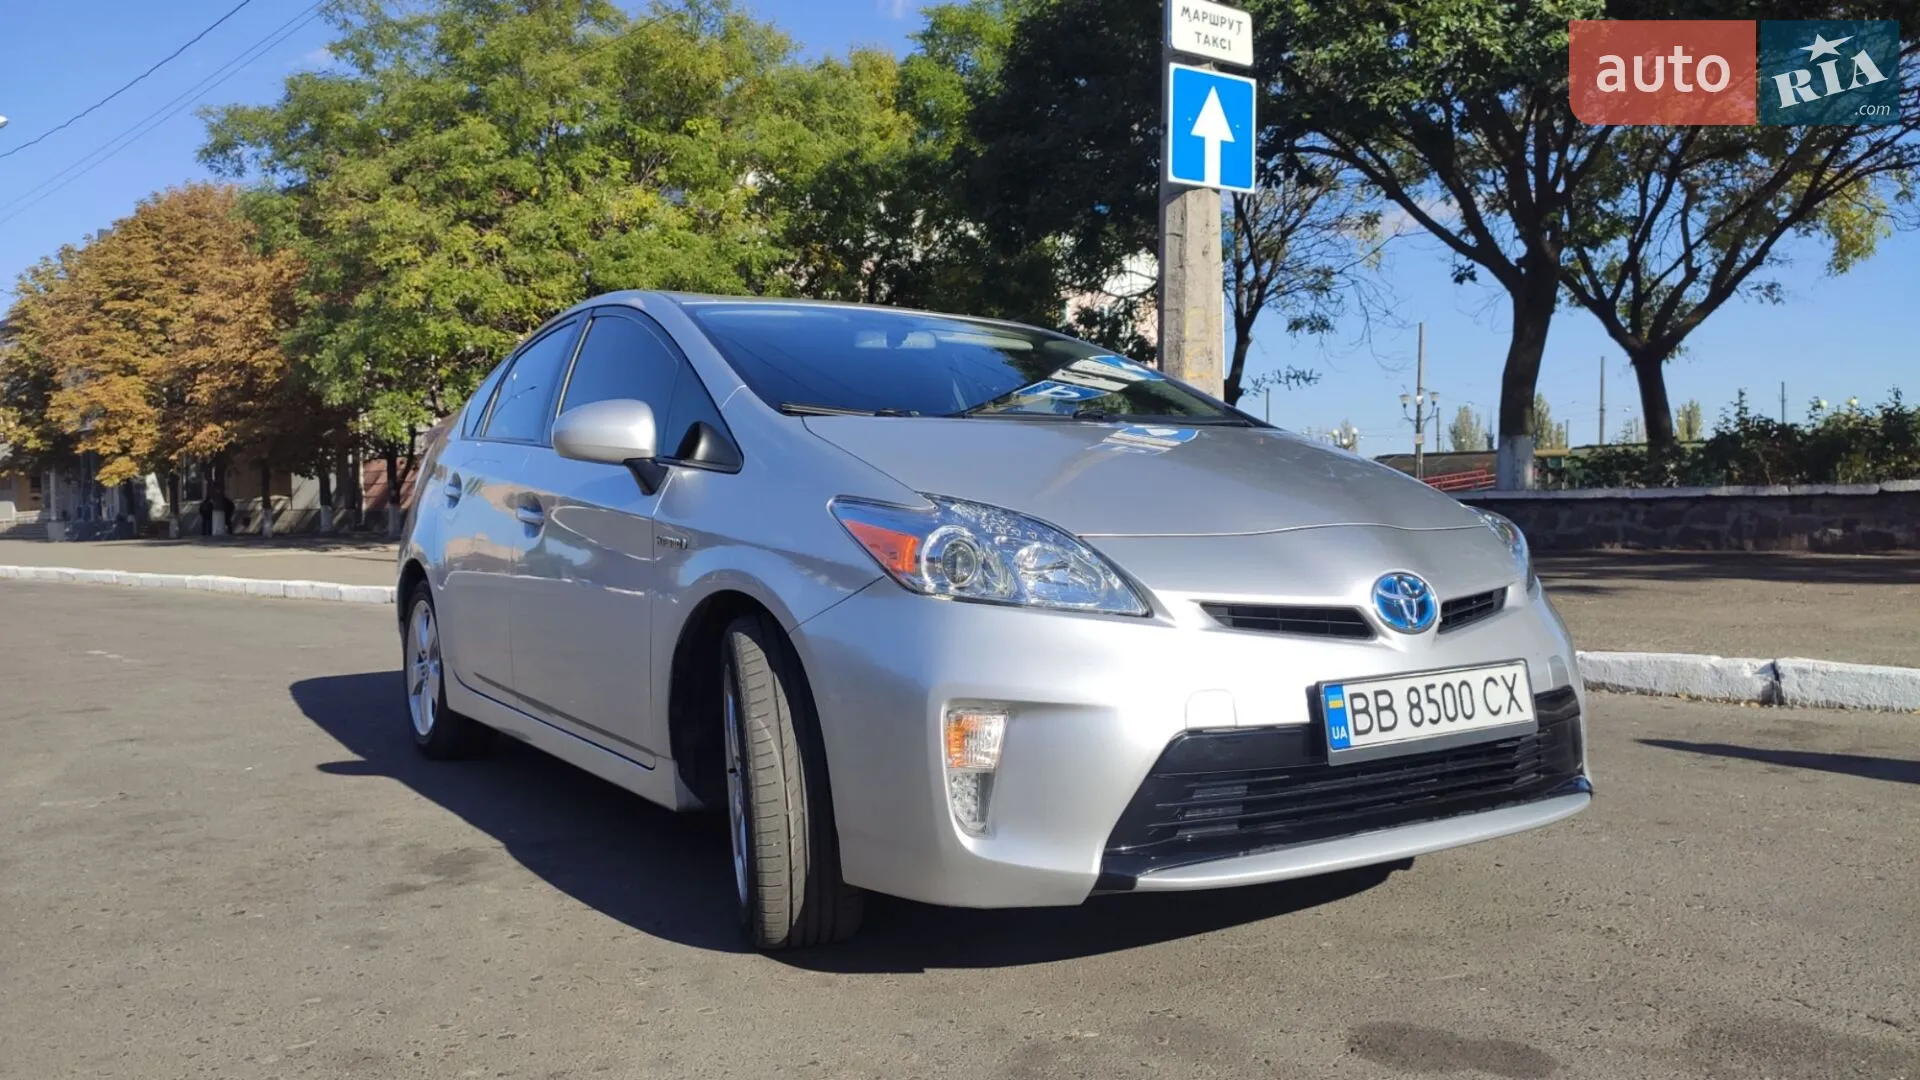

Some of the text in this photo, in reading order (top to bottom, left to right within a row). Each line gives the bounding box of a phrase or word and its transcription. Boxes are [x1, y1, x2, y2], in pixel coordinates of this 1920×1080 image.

[1181, 6, 1243, 35] МАРШРУТ
[1194, 31, 1232, 52] ТАКСІ
[1350, 672, 1524, 736] BB 8500 CX
[1332, 726, 1348, 740] UA
